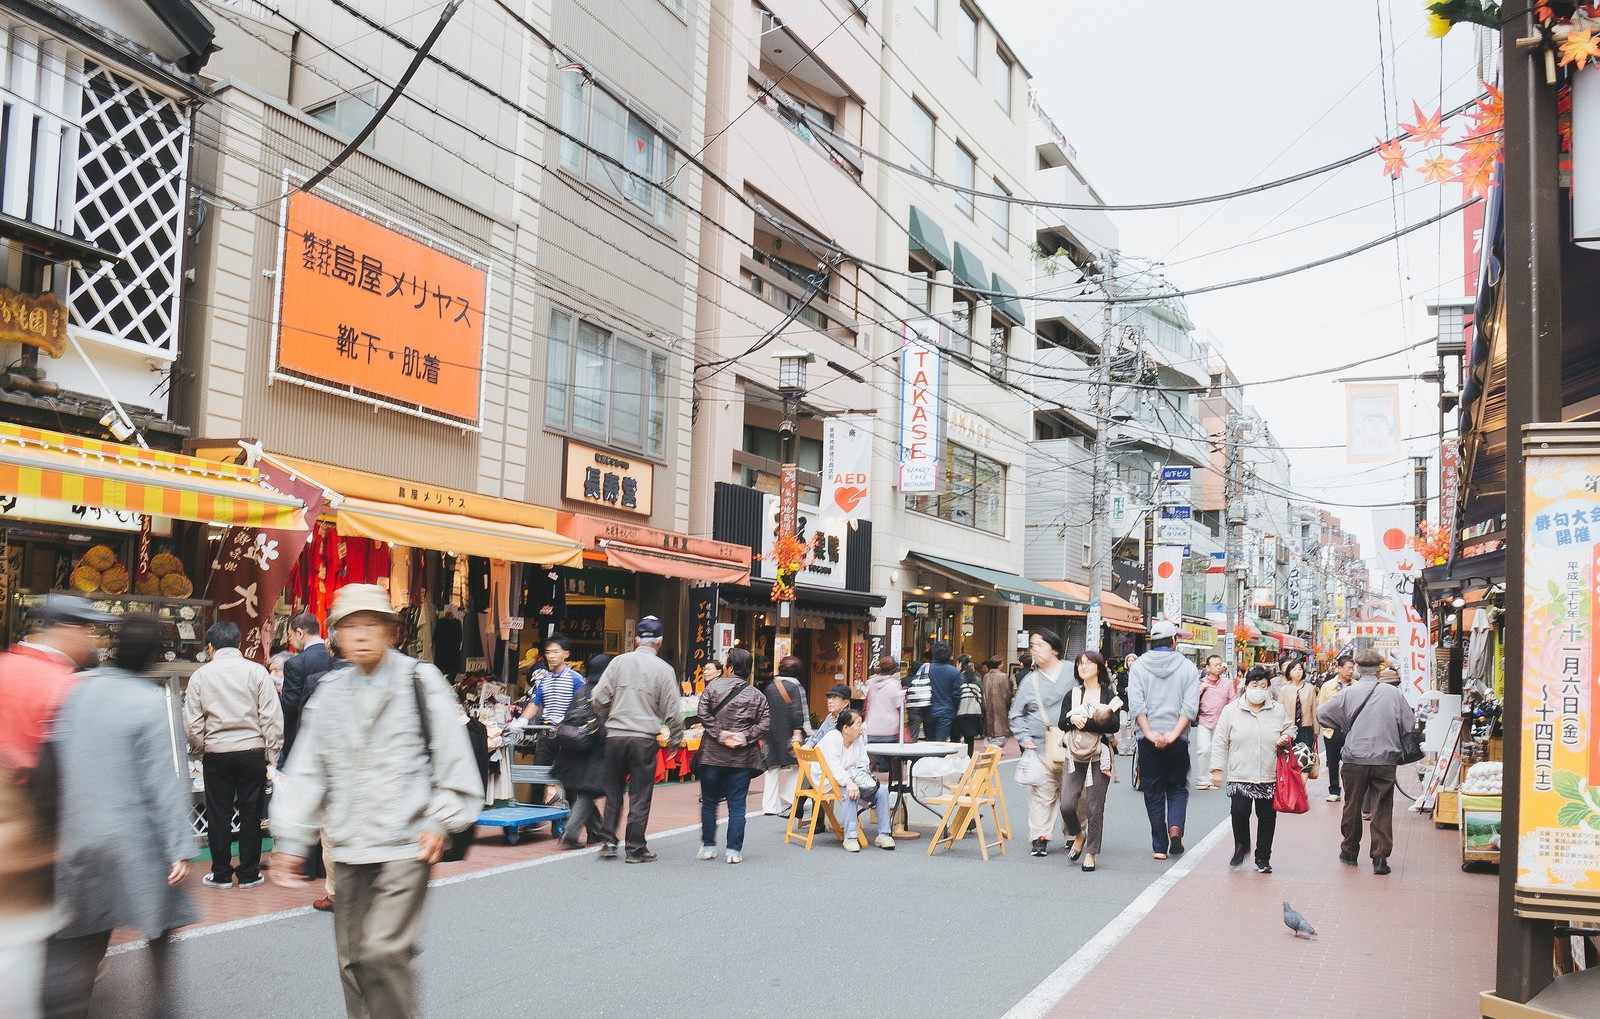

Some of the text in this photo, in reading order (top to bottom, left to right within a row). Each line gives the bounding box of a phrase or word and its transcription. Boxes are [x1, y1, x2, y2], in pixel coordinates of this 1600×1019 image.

[331, 244, 472, 329] 島屋メリヤス
[336, 323, 441, 385] 靴下・肌着
[911, 350, 929, 459] TAKASE
[398, 486, 466, 509] 島屋メリヤス
[833, 473, 867, 485] AED
[1535, 505, 1600, 531] 俳句大会
[1556, 526, 1591, 546] 開催
[1403, 603, 1428, 696] にんにく
